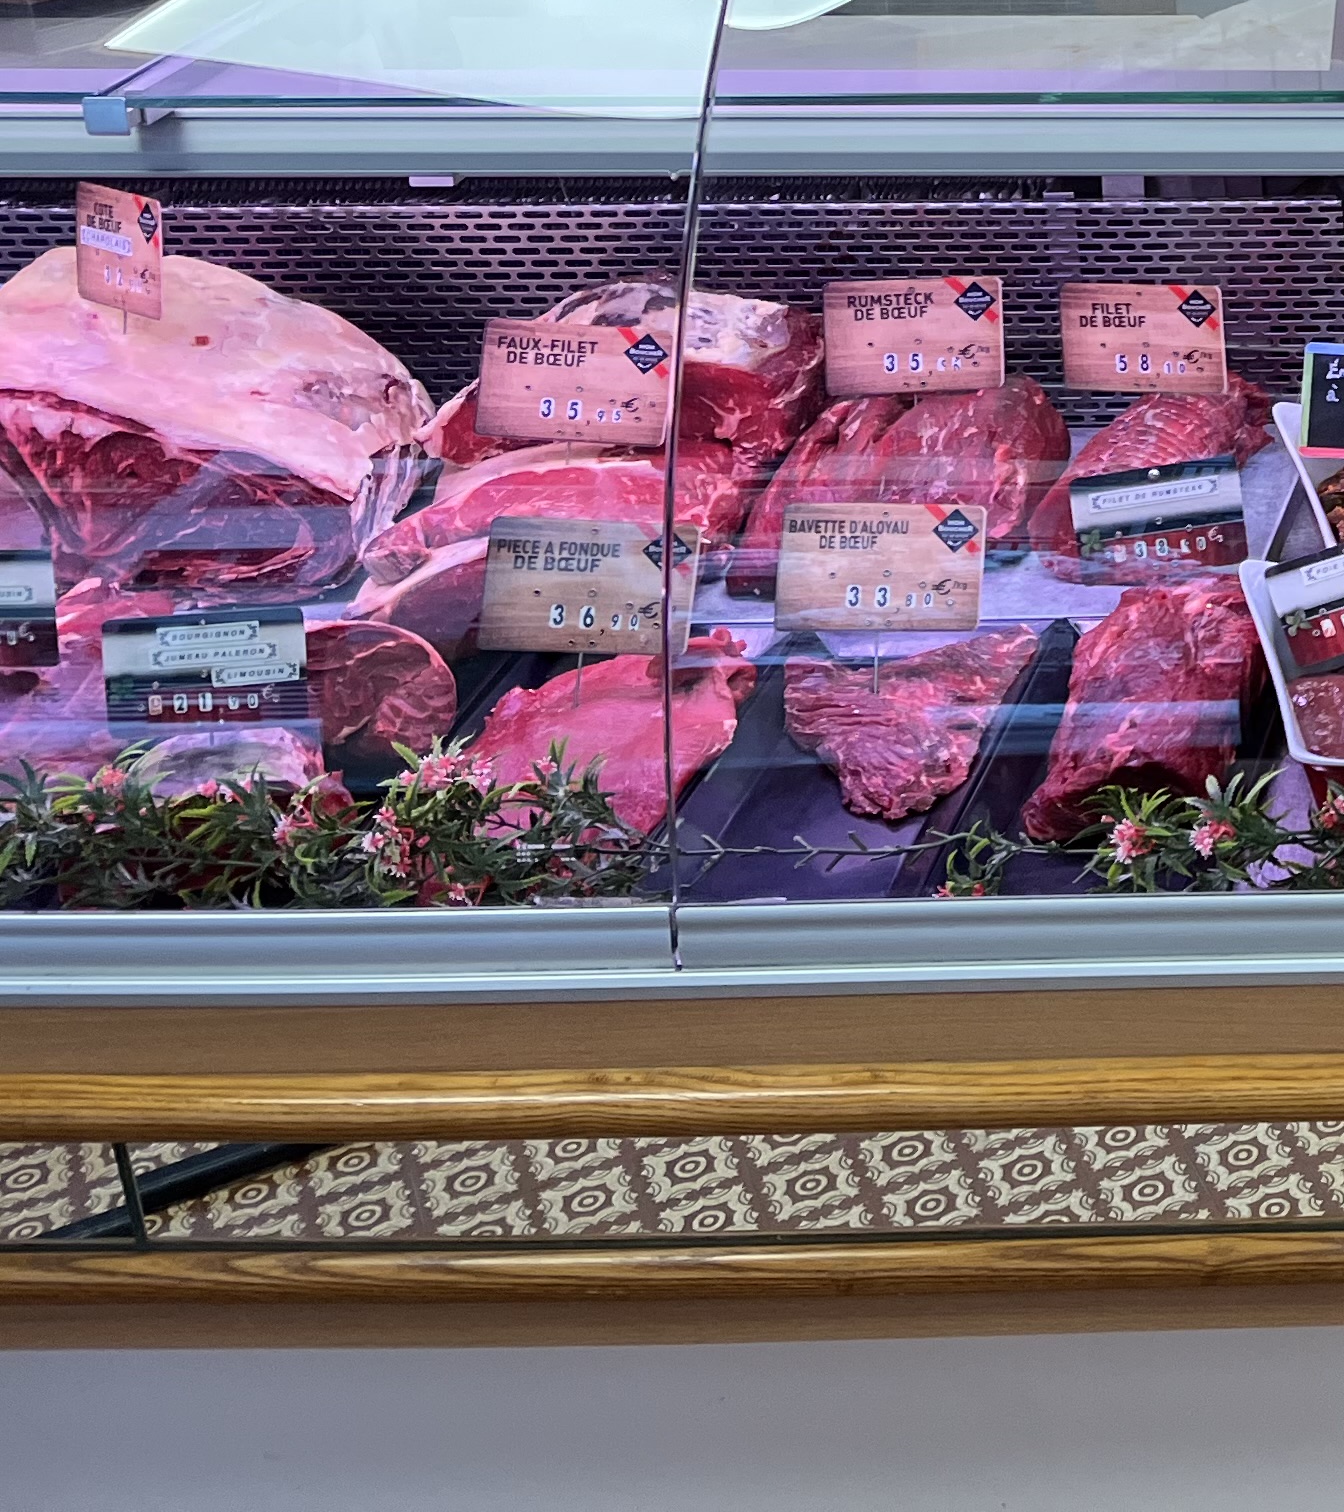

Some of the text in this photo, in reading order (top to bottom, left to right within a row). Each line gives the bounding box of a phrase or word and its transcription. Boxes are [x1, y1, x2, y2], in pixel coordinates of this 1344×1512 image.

[848, 292, 934, 308] RUMSTECK
[855, 306, 928, 321] DE BŒUF
[1092, 303, 1132, 315] FILET
[1080, 316, 1146, 328] DE BŒUF
[497, 336, 598, 354] FAUX-FILET
[506, 351, 587, 367] DE BŒUF
[1326, 384, 1339, 403] à
[789, 520, 910, 535] BAVETTE D'ALOYAU
[558, 541, 621, 558] FONDUE
[819, 536, 835, 549] DE
[513, 555, 601, 573] DE BŒUF
[1317, 564, 1339, 575] FOIE
[213, 647, 266, 660] PALERON
[227, 667, 285, 682] LIMOUSIN
